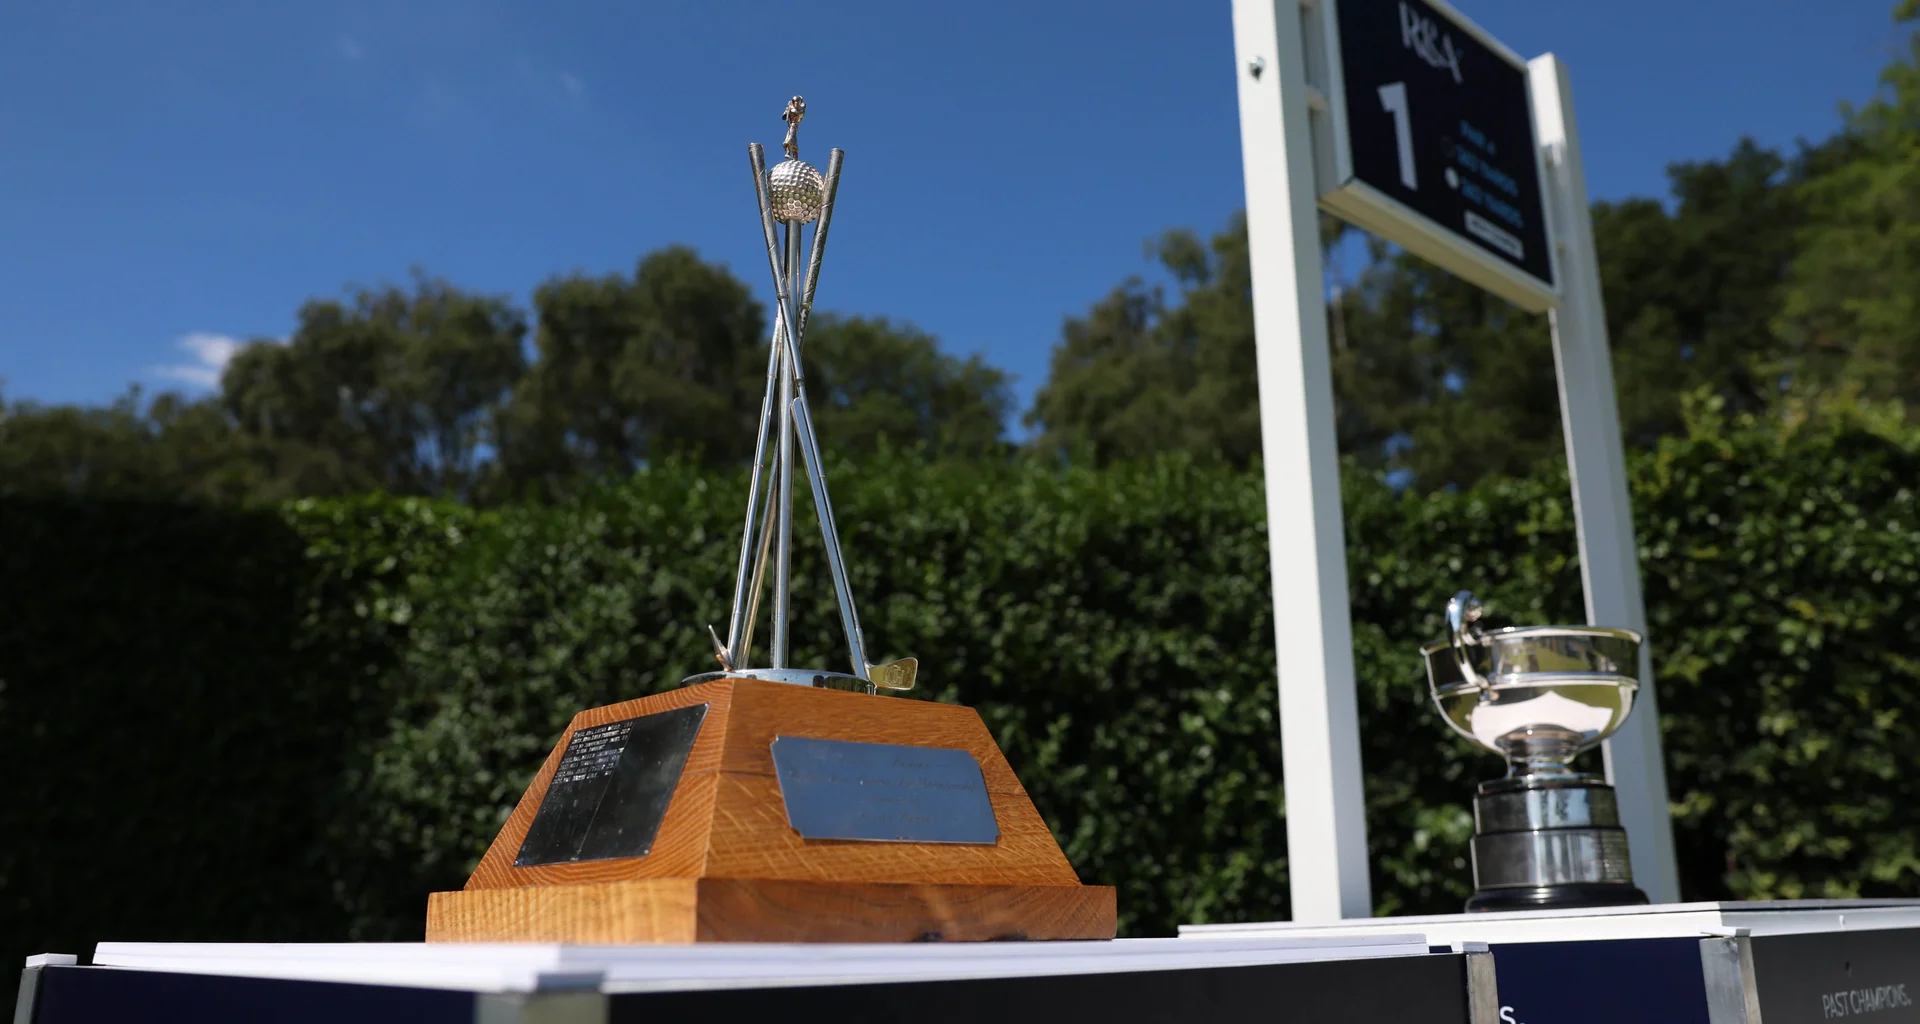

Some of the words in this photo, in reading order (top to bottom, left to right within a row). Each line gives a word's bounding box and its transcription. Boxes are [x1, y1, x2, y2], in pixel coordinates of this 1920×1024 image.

[1399, 0, 1463, 84] R&A
[1377, 81, 1418, 192] 1
[1822, 991, 1849, 1019] PAST
